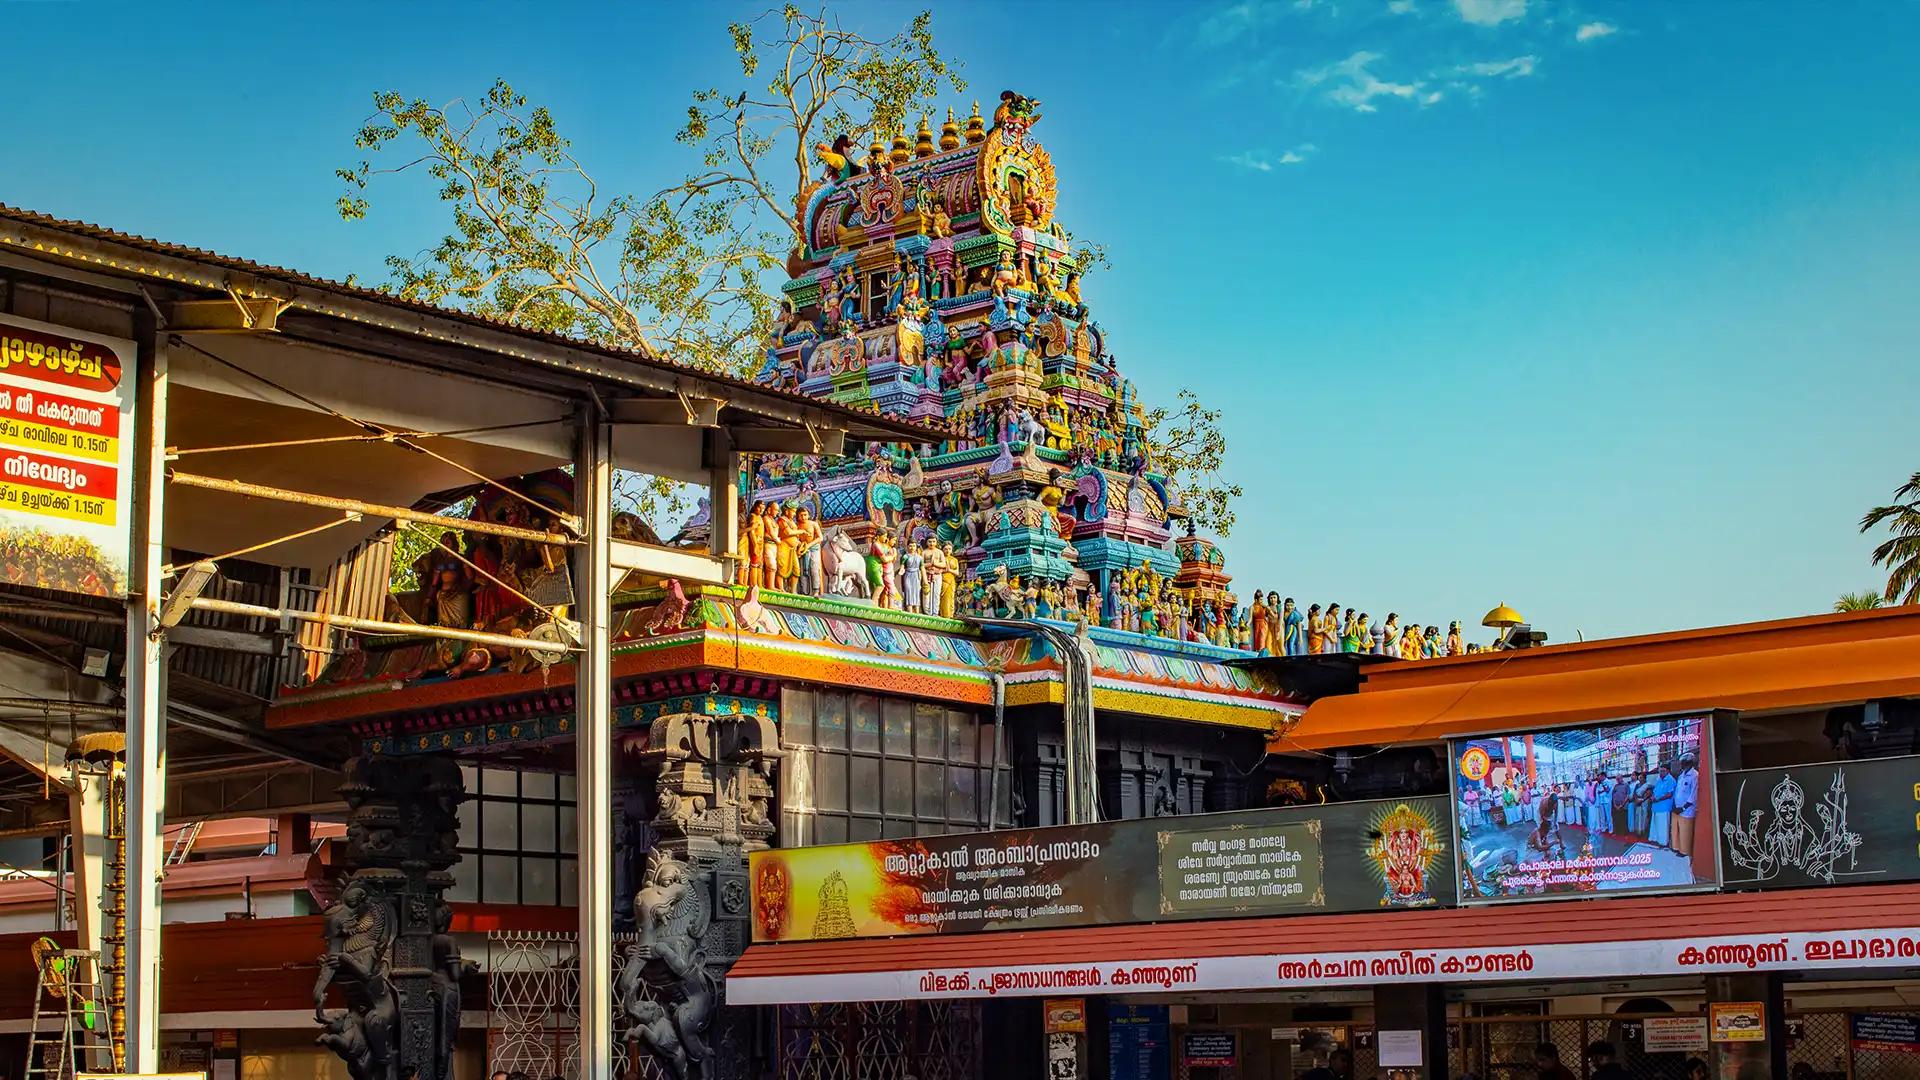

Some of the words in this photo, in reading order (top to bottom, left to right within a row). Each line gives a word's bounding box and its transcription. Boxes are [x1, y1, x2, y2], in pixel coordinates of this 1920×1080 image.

[16, 393, 33, 415] തീ
[37, 402, 104, 427] പകരുന്നത്
[23, 427, 67, 446] രാവിലെ
[72, 435, 110, 453] 10.15ന്
[4, 455, 87, 490] നിവേദ്യം
[74, 499, 105, 516] 1.15ന്
[885, 845, 969, 876] ആറ്റുകാൽ
[974, 840, 1100, 866] അംബാപ്രസാദം
[1629, 852, 1652, 866] 2025
[922, 887, 980, 905] വായിക്കുക
[983, 883, 1063, 901] വരിക്കാരാവുക
[1278, 957, 1366, 980] അർച്ചന
[1371, 949, 1437, 977] രസീത്
[1628, 1028, 1636, 1039] 3
[1789, 1024, 1797, 1035] 2
